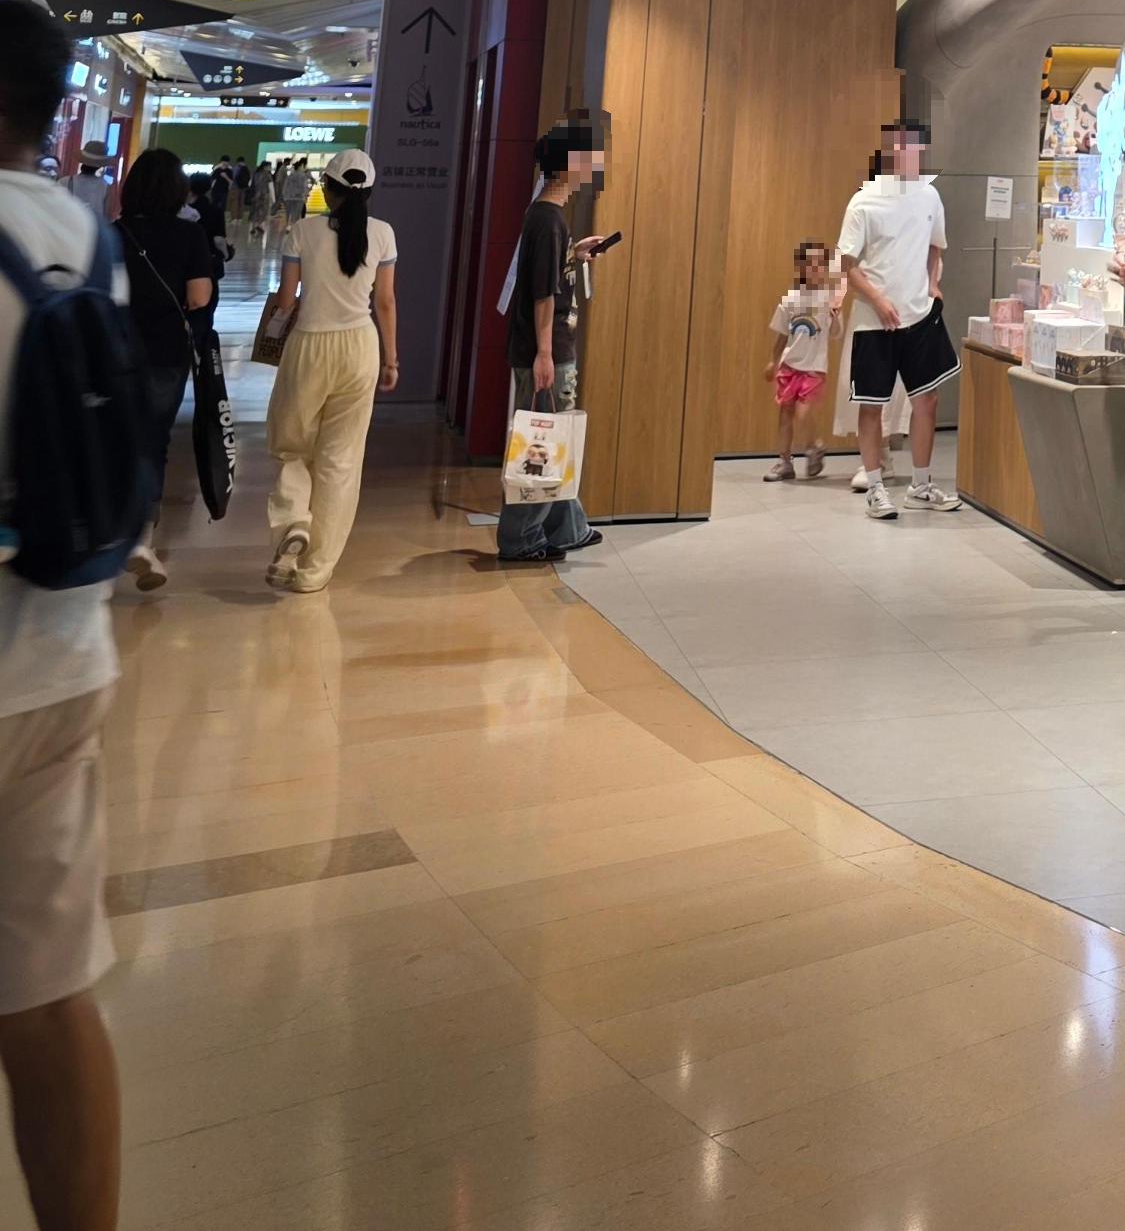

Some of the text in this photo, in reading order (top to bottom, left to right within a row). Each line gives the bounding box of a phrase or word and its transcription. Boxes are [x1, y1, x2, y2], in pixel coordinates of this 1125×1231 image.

[399, 118, 441, 131] nautica
[283, 126, 336, 142] LOEWE
[382, 165, 449, 177] 店铺正常营业
[217, 399, 236, 469] VICTOR
